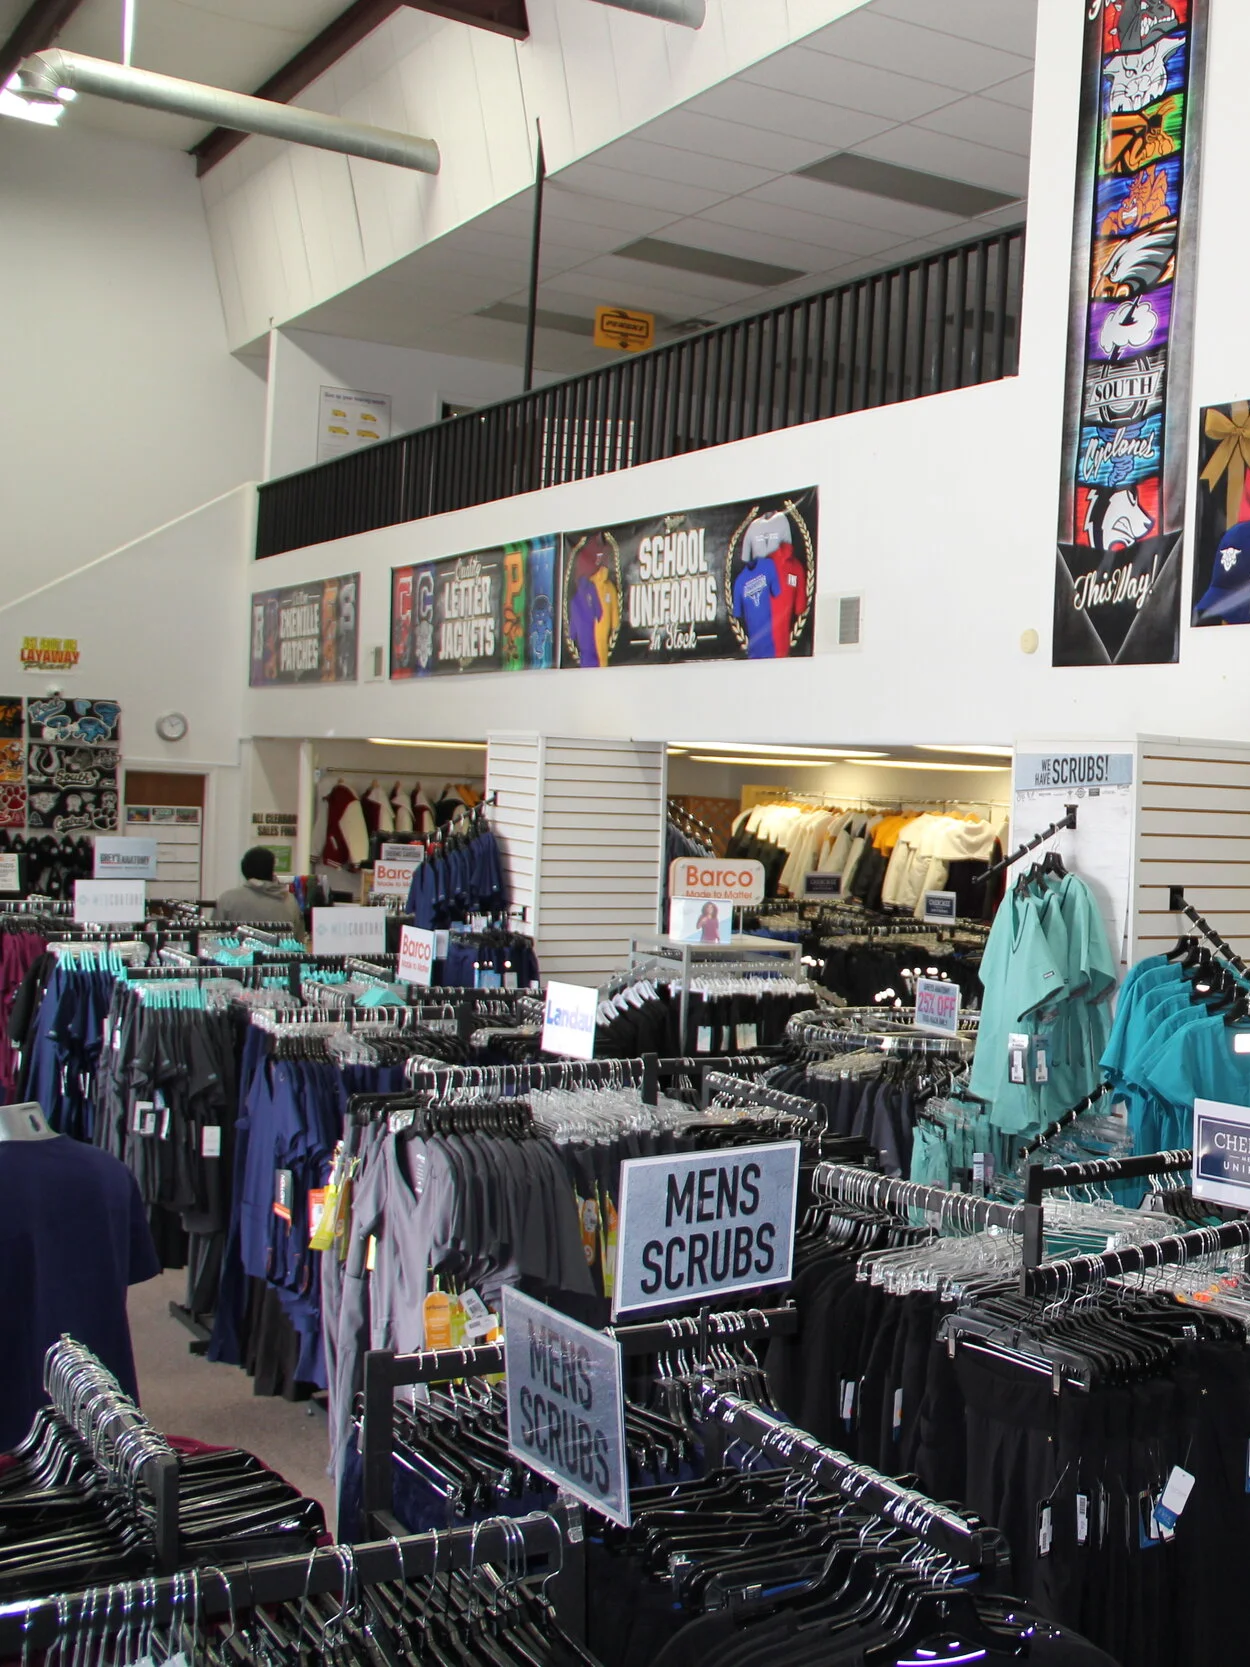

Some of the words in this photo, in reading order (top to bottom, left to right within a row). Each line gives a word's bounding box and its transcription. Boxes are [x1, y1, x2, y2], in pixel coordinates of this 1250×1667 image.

[1094, 375, 1155, 402] SOUTH
[1083, 428, 1155, 482] Cyclones
[639, 528, 708, 580] SCHOOL
[444, 576, 491, 619] LETTER
[1073, 570, 1113, 610] This
[1112, 554, 1158, 609] Way!
[629, 575, 717, 628] UNIFORMS
[438, 617, 495, 660] JACKETS
[649, 624, 661, 650] In
[665, 622, 697, 650] Stock
[20, 648, 79, 664] LAYAWAY
[280, 639, 319, 672] PATCHES
[1035, 772, 1051, 786] HAVE
[1052, 755, 1109, 784] SCRUBS!
[1042, 759, 1051, 771] WE
[377, 865, 413, 879] Barc
[686, 865, 753, 887] Barco
[686, 890, 712, 898] Made
[713, 890, 722, 898] to
[724, 891, 753, 899] Matter
[402, 933, 431, 960] Barco
[546, 999, 593, 1033] Landau
[918, 991, 935, 1014] 25%
[937, 995, 956, 1018] OFF
[665, 1162, 761, 1227] MENS
[640, 1222, 775, 1295] SCRUBS
[527, 1318, 593, 1410] MENS
[520, 1385, 611, 1494] SCRUBS
